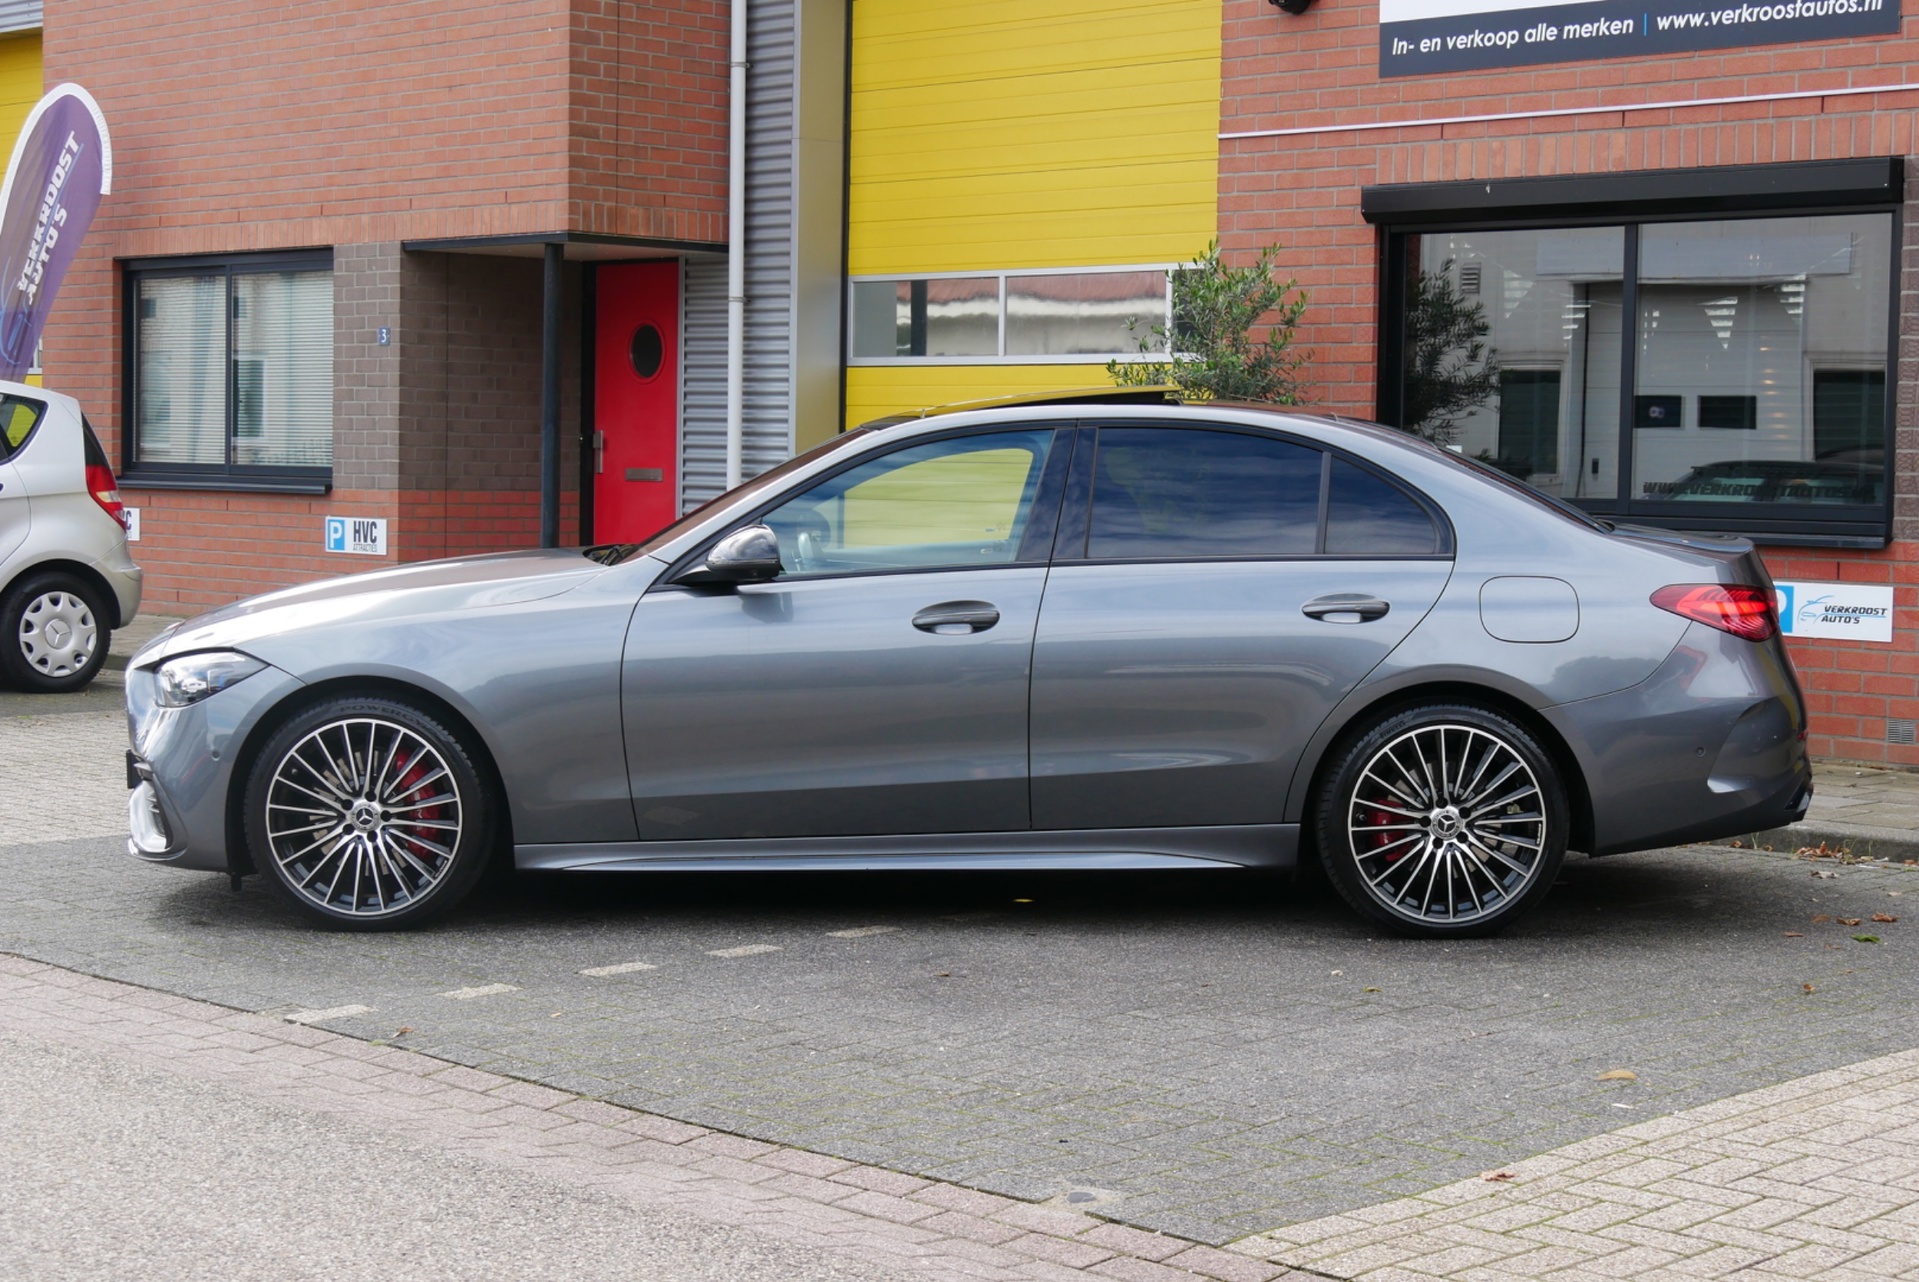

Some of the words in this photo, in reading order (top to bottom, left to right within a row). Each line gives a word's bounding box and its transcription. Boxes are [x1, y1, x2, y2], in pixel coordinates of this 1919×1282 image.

[1392, 37, 1415, 55] In-
[1419, 36, 1441, 52] en
[1446, 29, 1519, 50] verkoop
[1524, 23, 1558, 43] alle
[1562, 17, 1634, 40] merken
[381, 329, 387, 343] 3
[330, 521, 342, 548] P
[353, 520, 377, 543] HVC
[1821, 615, 1860, 624] AUTO'S
[1824, 605, 1887, 616] VERKROOST
